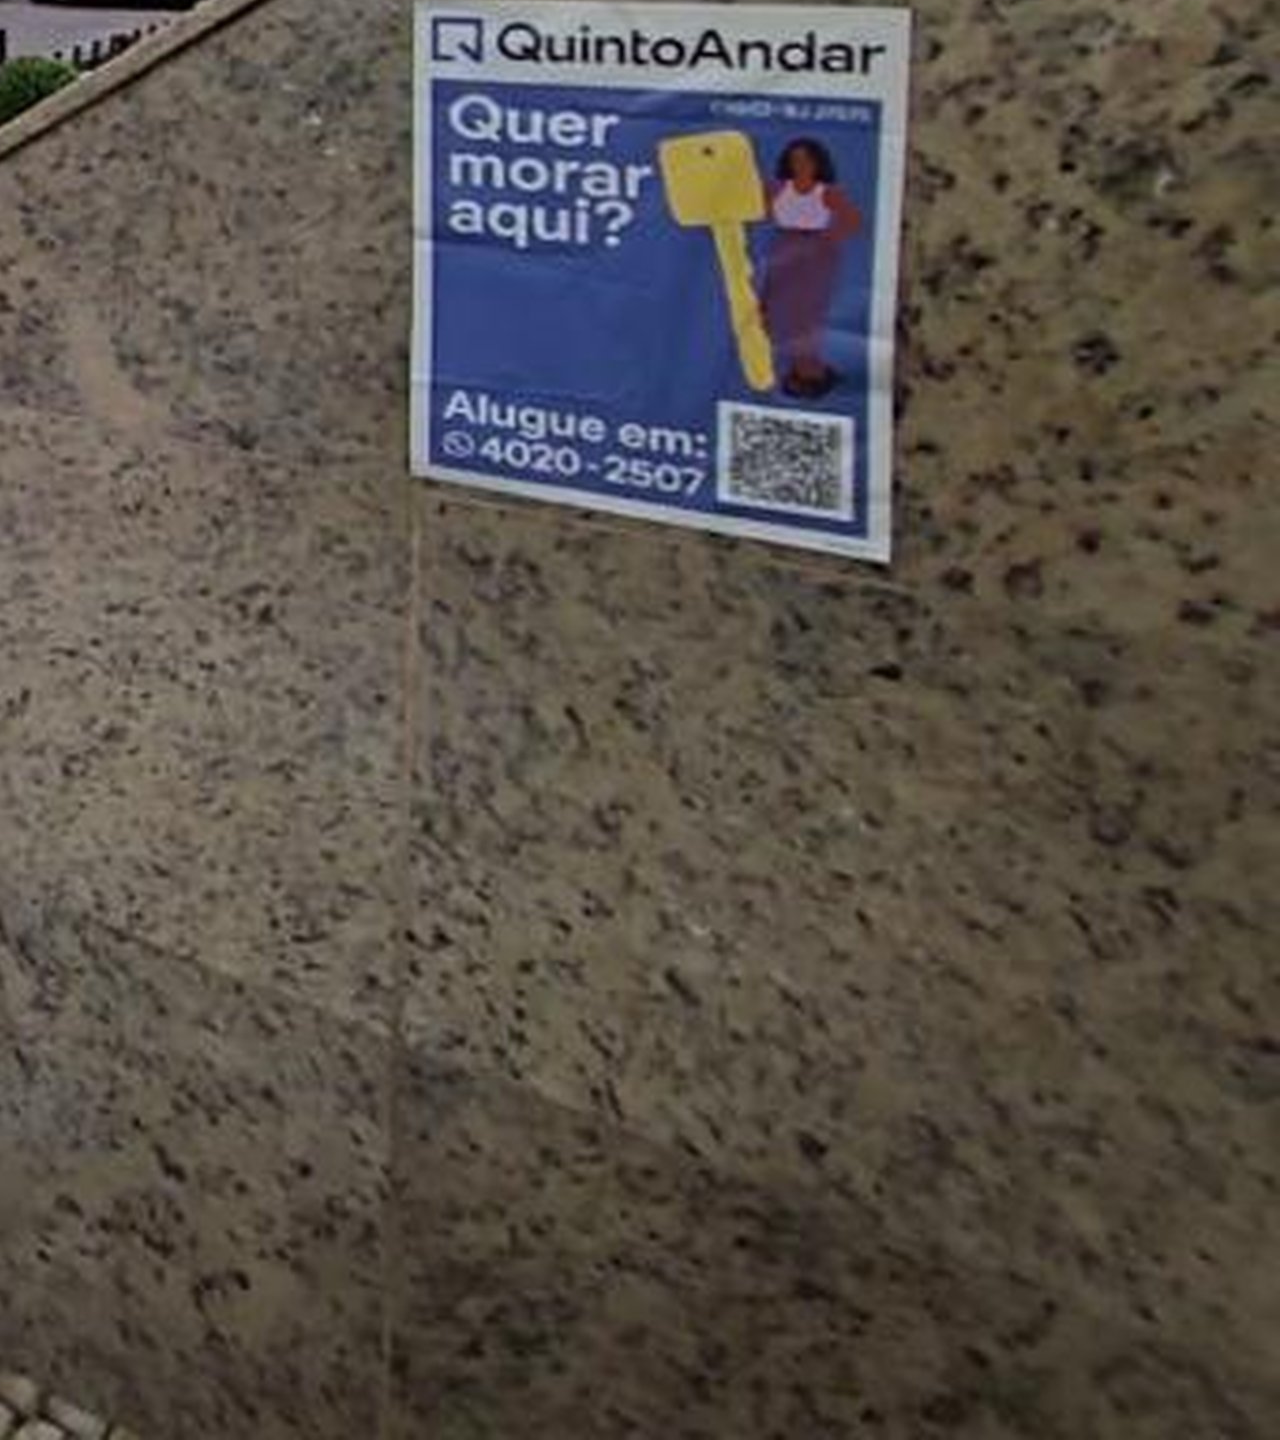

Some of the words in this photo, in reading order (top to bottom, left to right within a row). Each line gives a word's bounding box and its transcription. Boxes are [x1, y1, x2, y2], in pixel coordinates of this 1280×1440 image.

[497, 22, 886, 74] QuintoAndar
[449, 95, 620, 147] Quer
[449, 152, 652, 198] morar
[449, 199, 634, 248] aqui?
[445, 391, 608, 441] Alugue
[618, 423, 707, 458] em:
